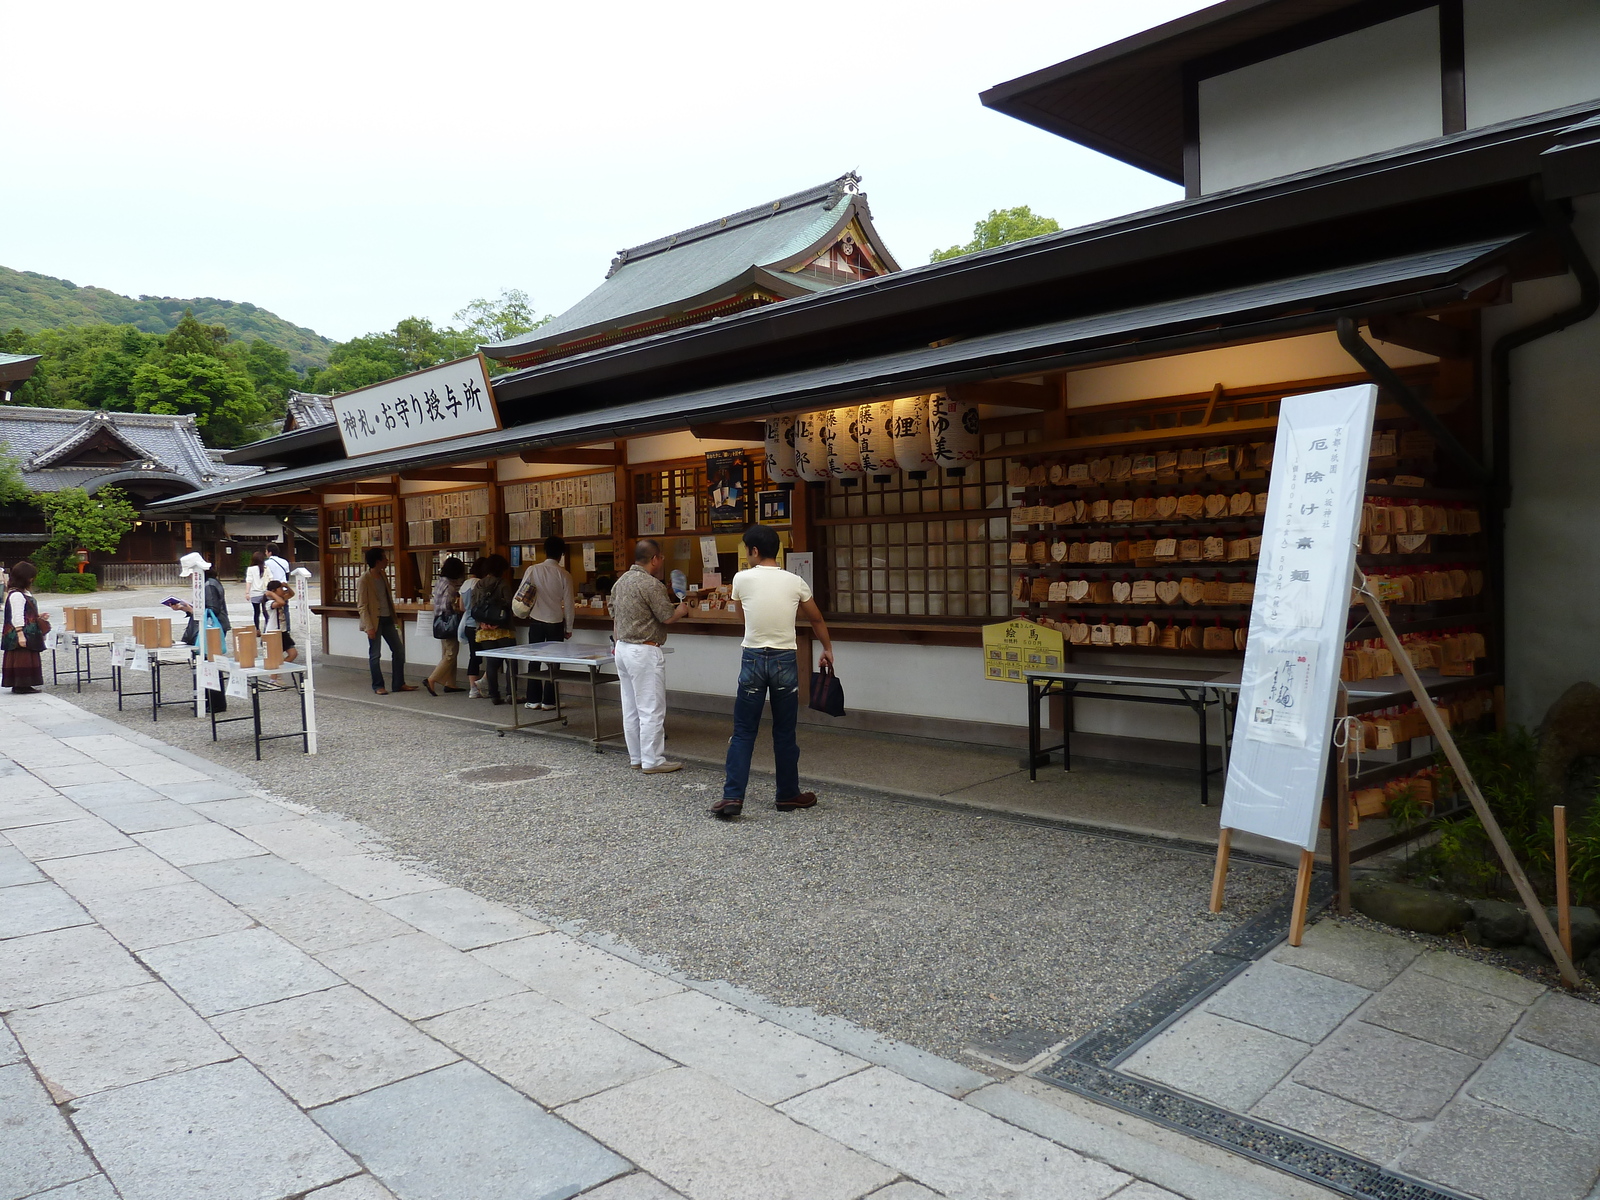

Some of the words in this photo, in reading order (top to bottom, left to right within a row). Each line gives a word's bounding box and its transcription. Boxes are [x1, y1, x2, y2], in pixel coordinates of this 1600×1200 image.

[343, 378, 482, 440] 神札・お守り授与所
[858, 403, 879, 471] 藤山直美
[893, 416, 916, 439] 狸
[932, 395, 956, 461] まゆ美
